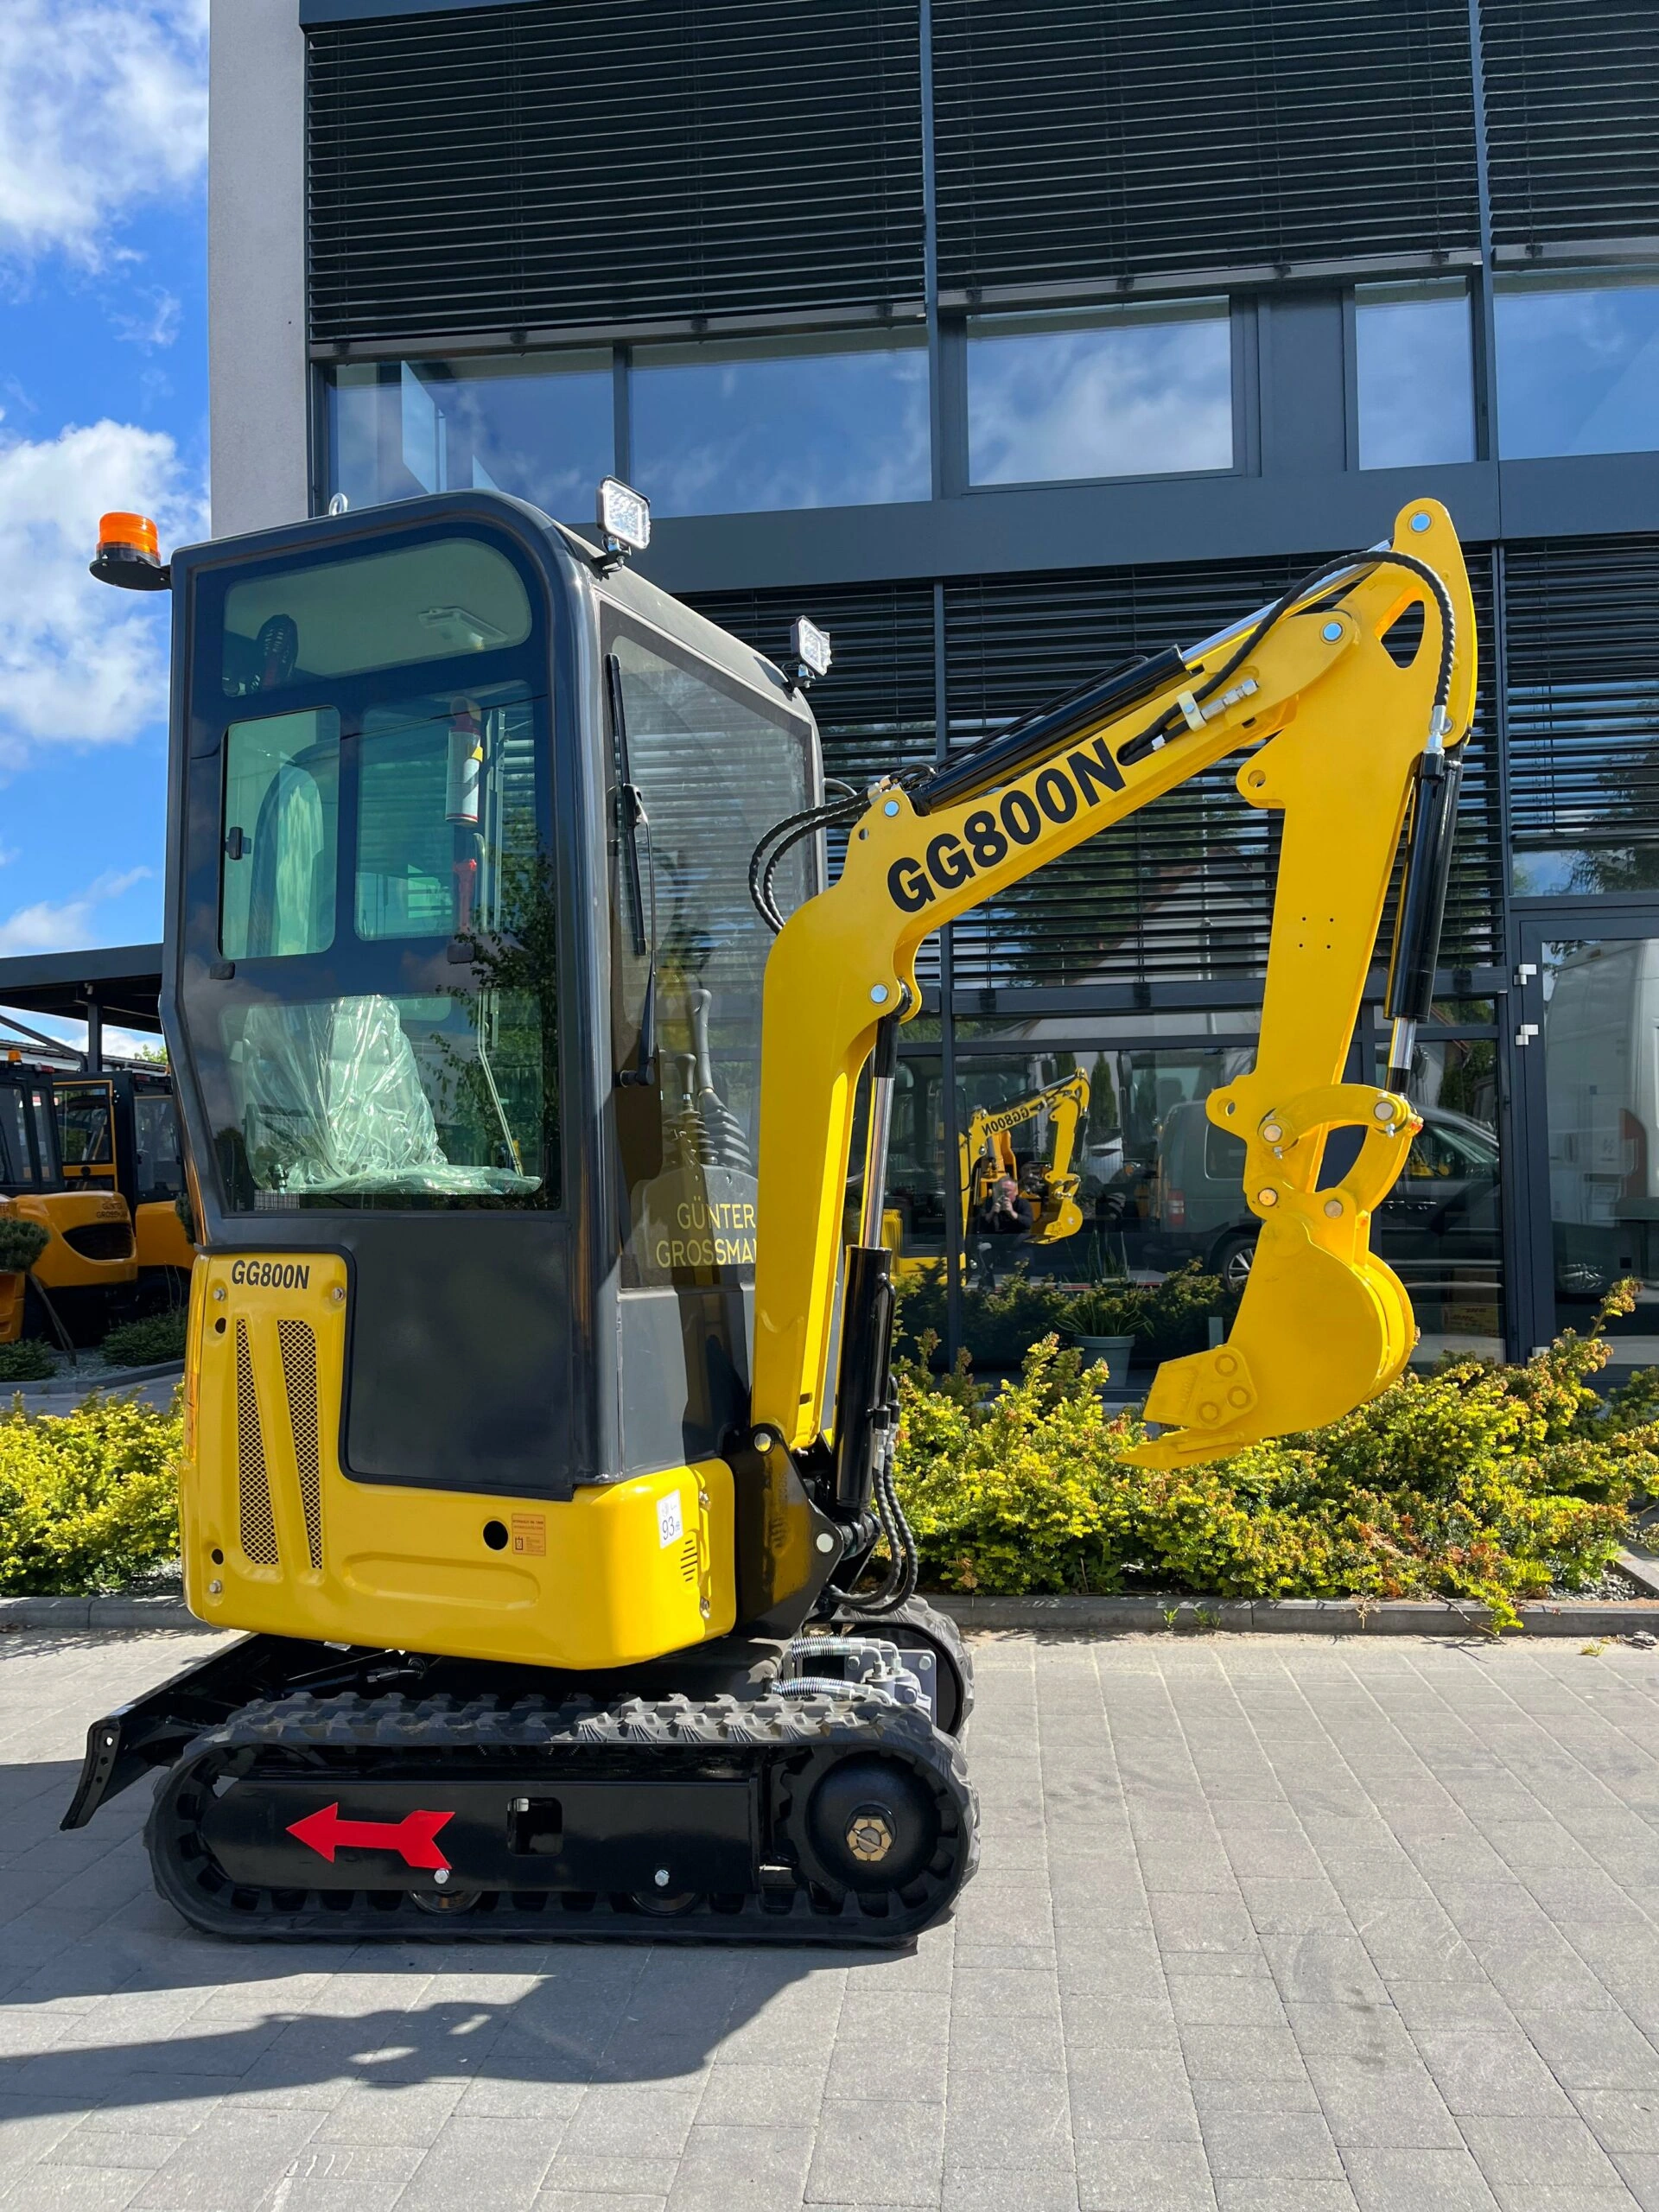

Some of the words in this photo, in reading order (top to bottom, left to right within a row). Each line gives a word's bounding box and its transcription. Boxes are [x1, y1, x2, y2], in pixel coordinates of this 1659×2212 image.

[887, 736, 1127, 912] GG800N
[677, 1196, 756, 1230] GÜNTER
[656, 1237, 757, 1268] GROSSMA
[232, 1260, 310, 1289] GG800N
[662, 1516, 675, 1541] 93
